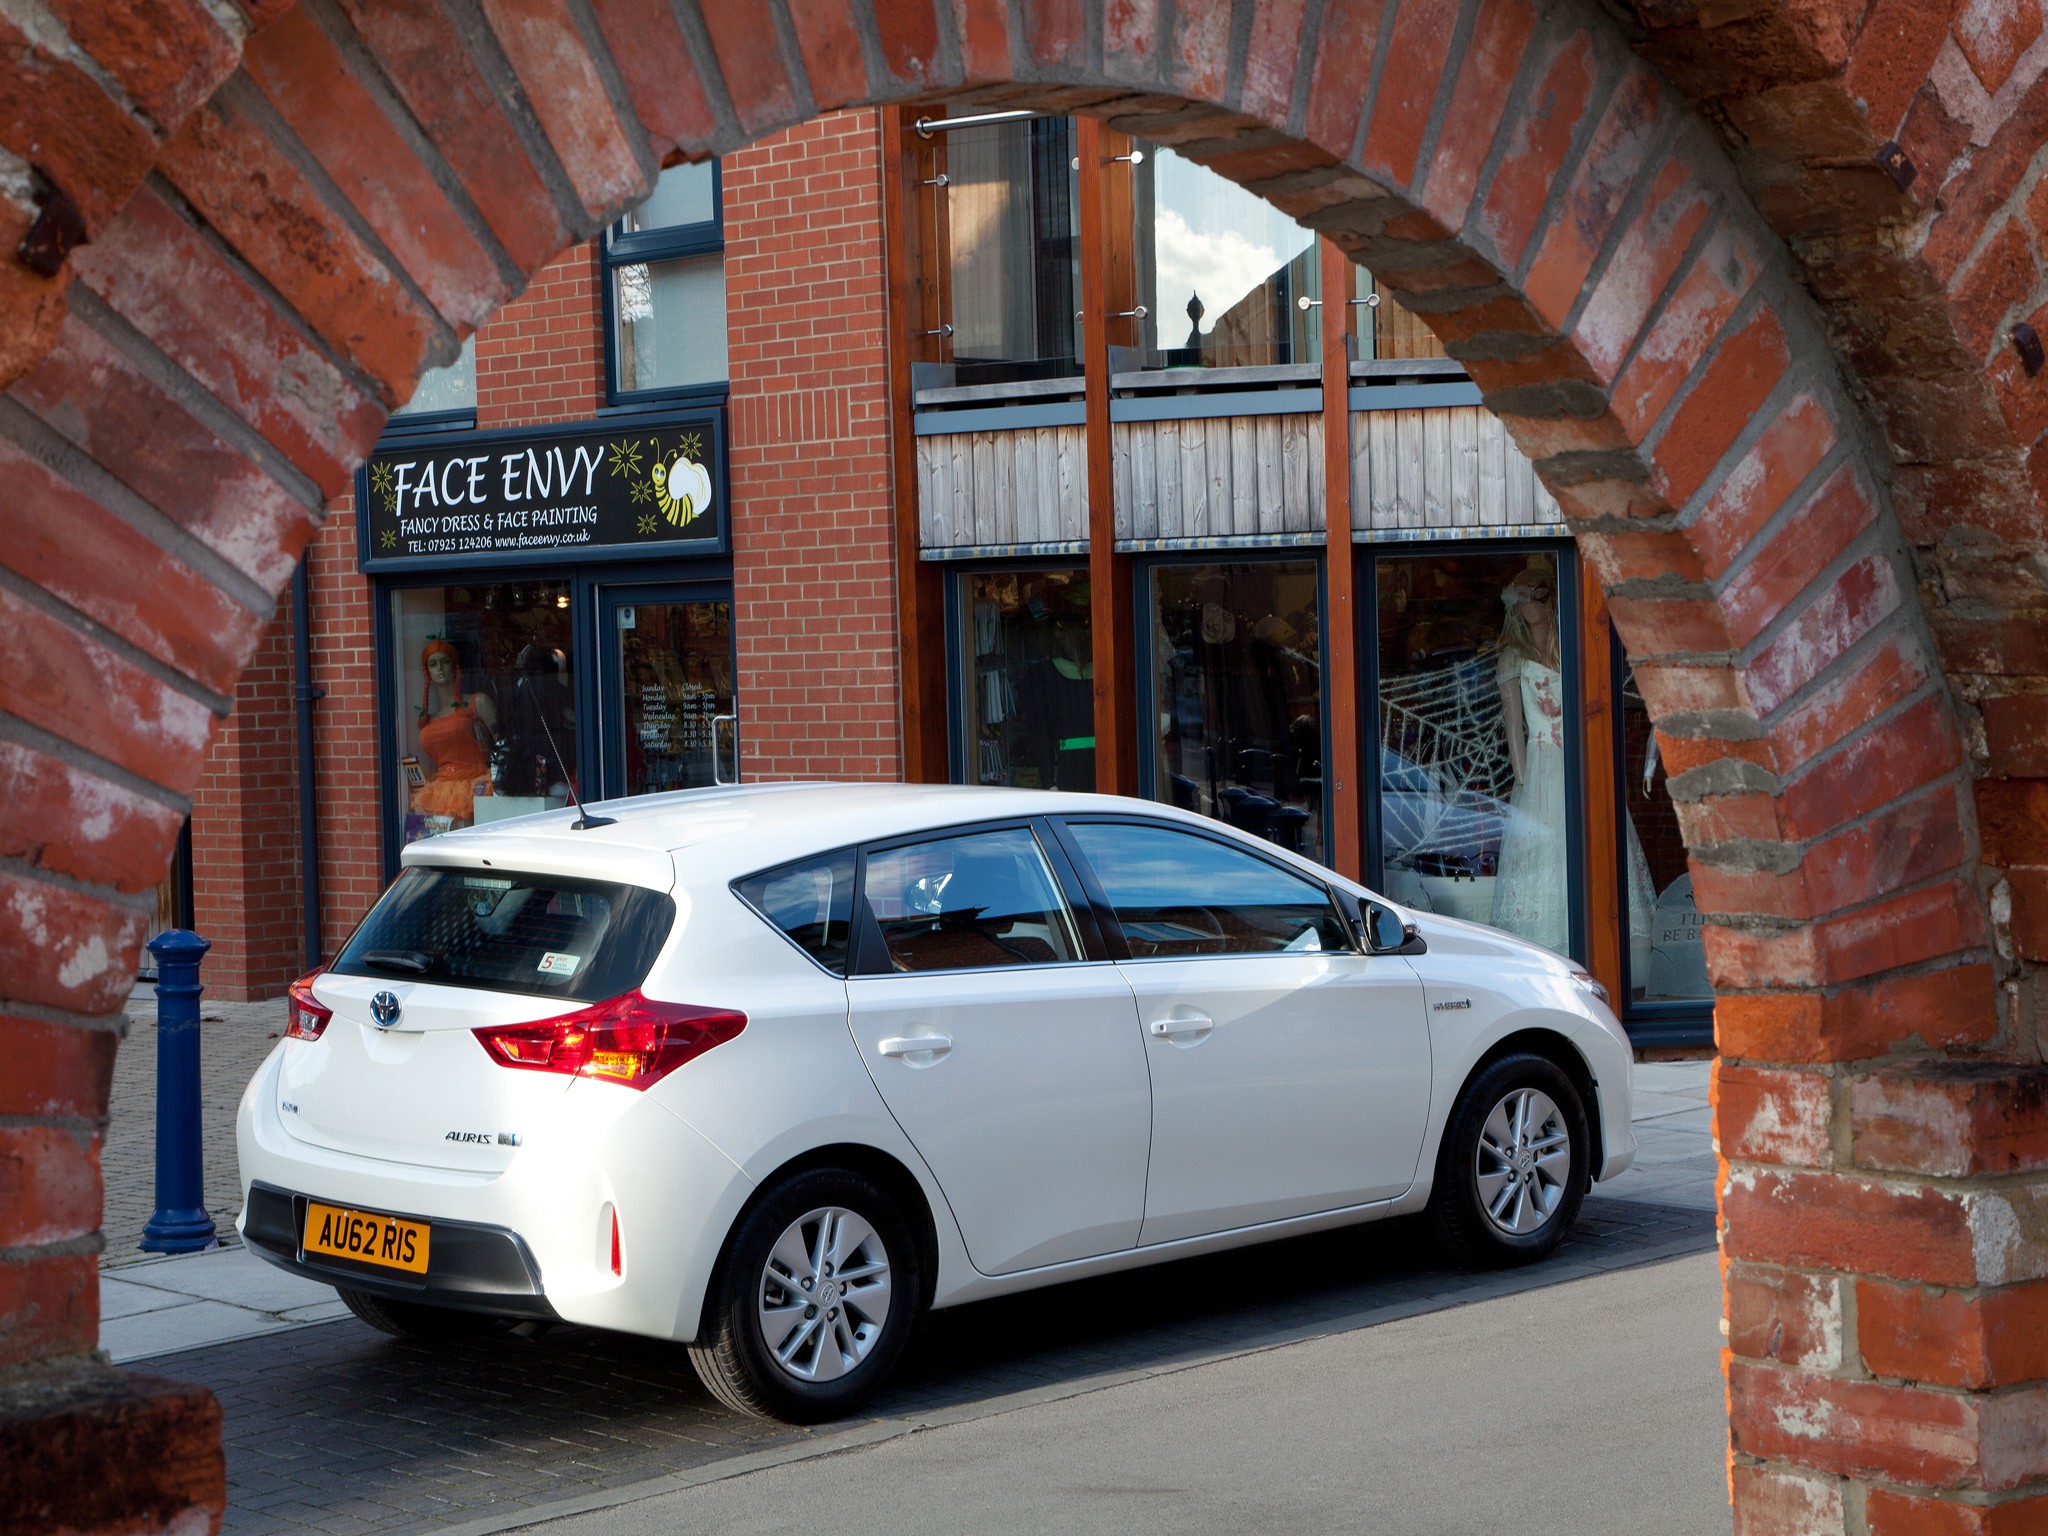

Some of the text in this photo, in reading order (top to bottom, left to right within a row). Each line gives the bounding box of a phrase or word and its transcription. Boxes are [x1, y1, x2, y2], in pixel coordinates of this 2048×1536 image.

[393, 446, 605, 517] FACE ENVY
[400, 506, 598, 537] FANCY DRESS & FACE PAINTING
[408, 528, 591, 553] TEL: 07925 124206 www.faceenvy.co.uk
[642, 682, 702, 693] Sunday Closed
[642, 693, 666, 703] Monday
[643, 703, 667, 712] Tuesday
[703, 702, 716, 711] 5pm
[643, 712, 676, 723] Wednesday
[644, 722, 671, 731] Thursday
[643, 731, 664, 740] Friday
[683, 730, 696, 738] 8.30
[702, 730, 712, 738] 5.3
[644, 740, 672, 751] Saturday
[684, 740, 697, 748] 8.30
[1663, 929, 1682, 942] BE
[541, 956, 555, 969] 5
[445, 1131, 493, 1145] AURIS
[318, 1213, 417, 1263] AU62 RIS
